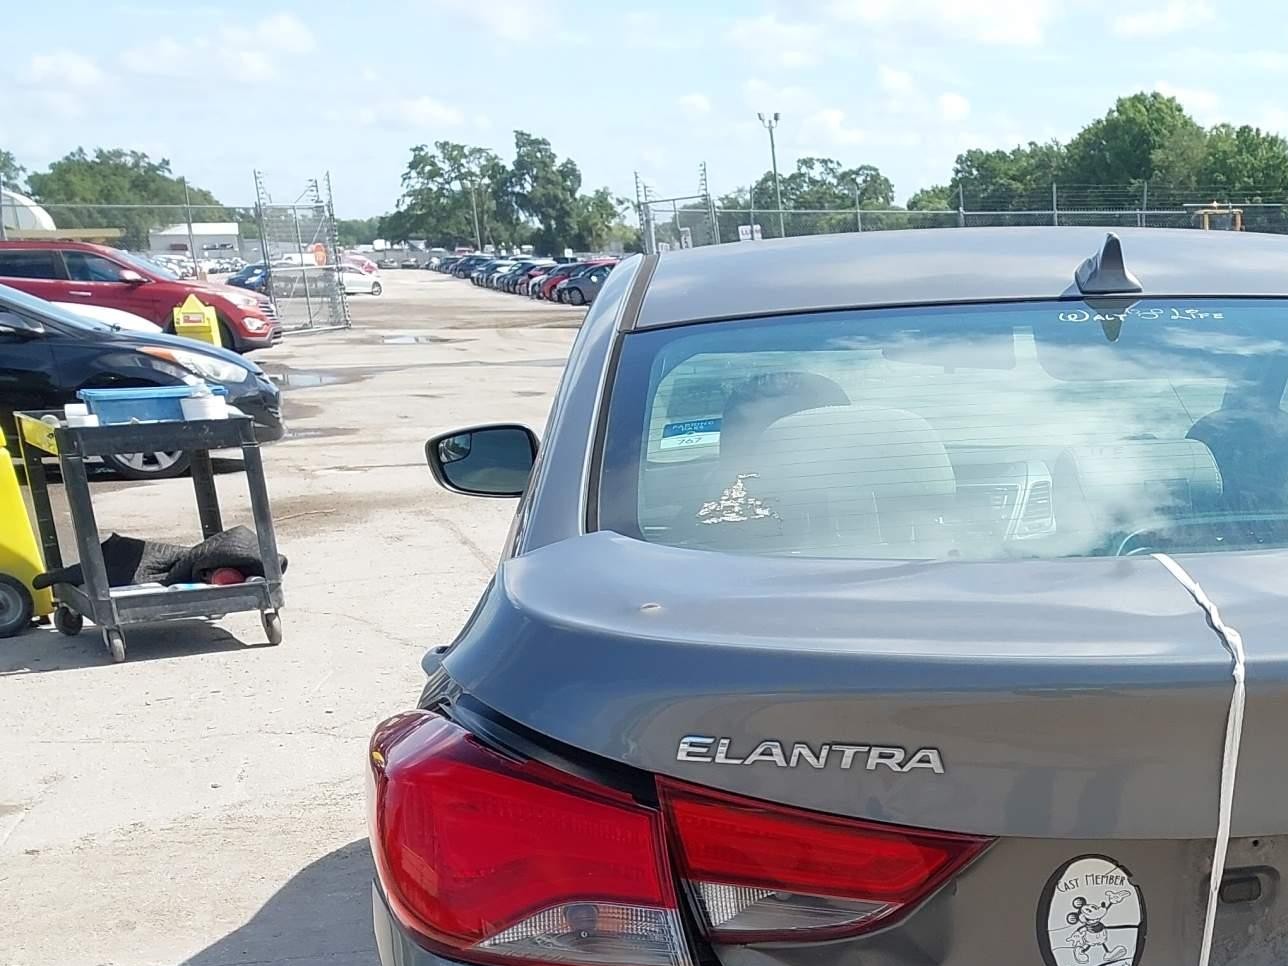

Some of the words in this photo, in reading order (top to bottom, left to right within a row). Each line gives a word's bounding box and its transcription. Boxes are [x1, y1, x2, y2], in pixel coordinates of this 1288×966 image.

[675, 734, 946, 774] ELANTRA
[1056, 877, 1080, 893] CAST
[1085, 873, 1126, 887] MEMBER
